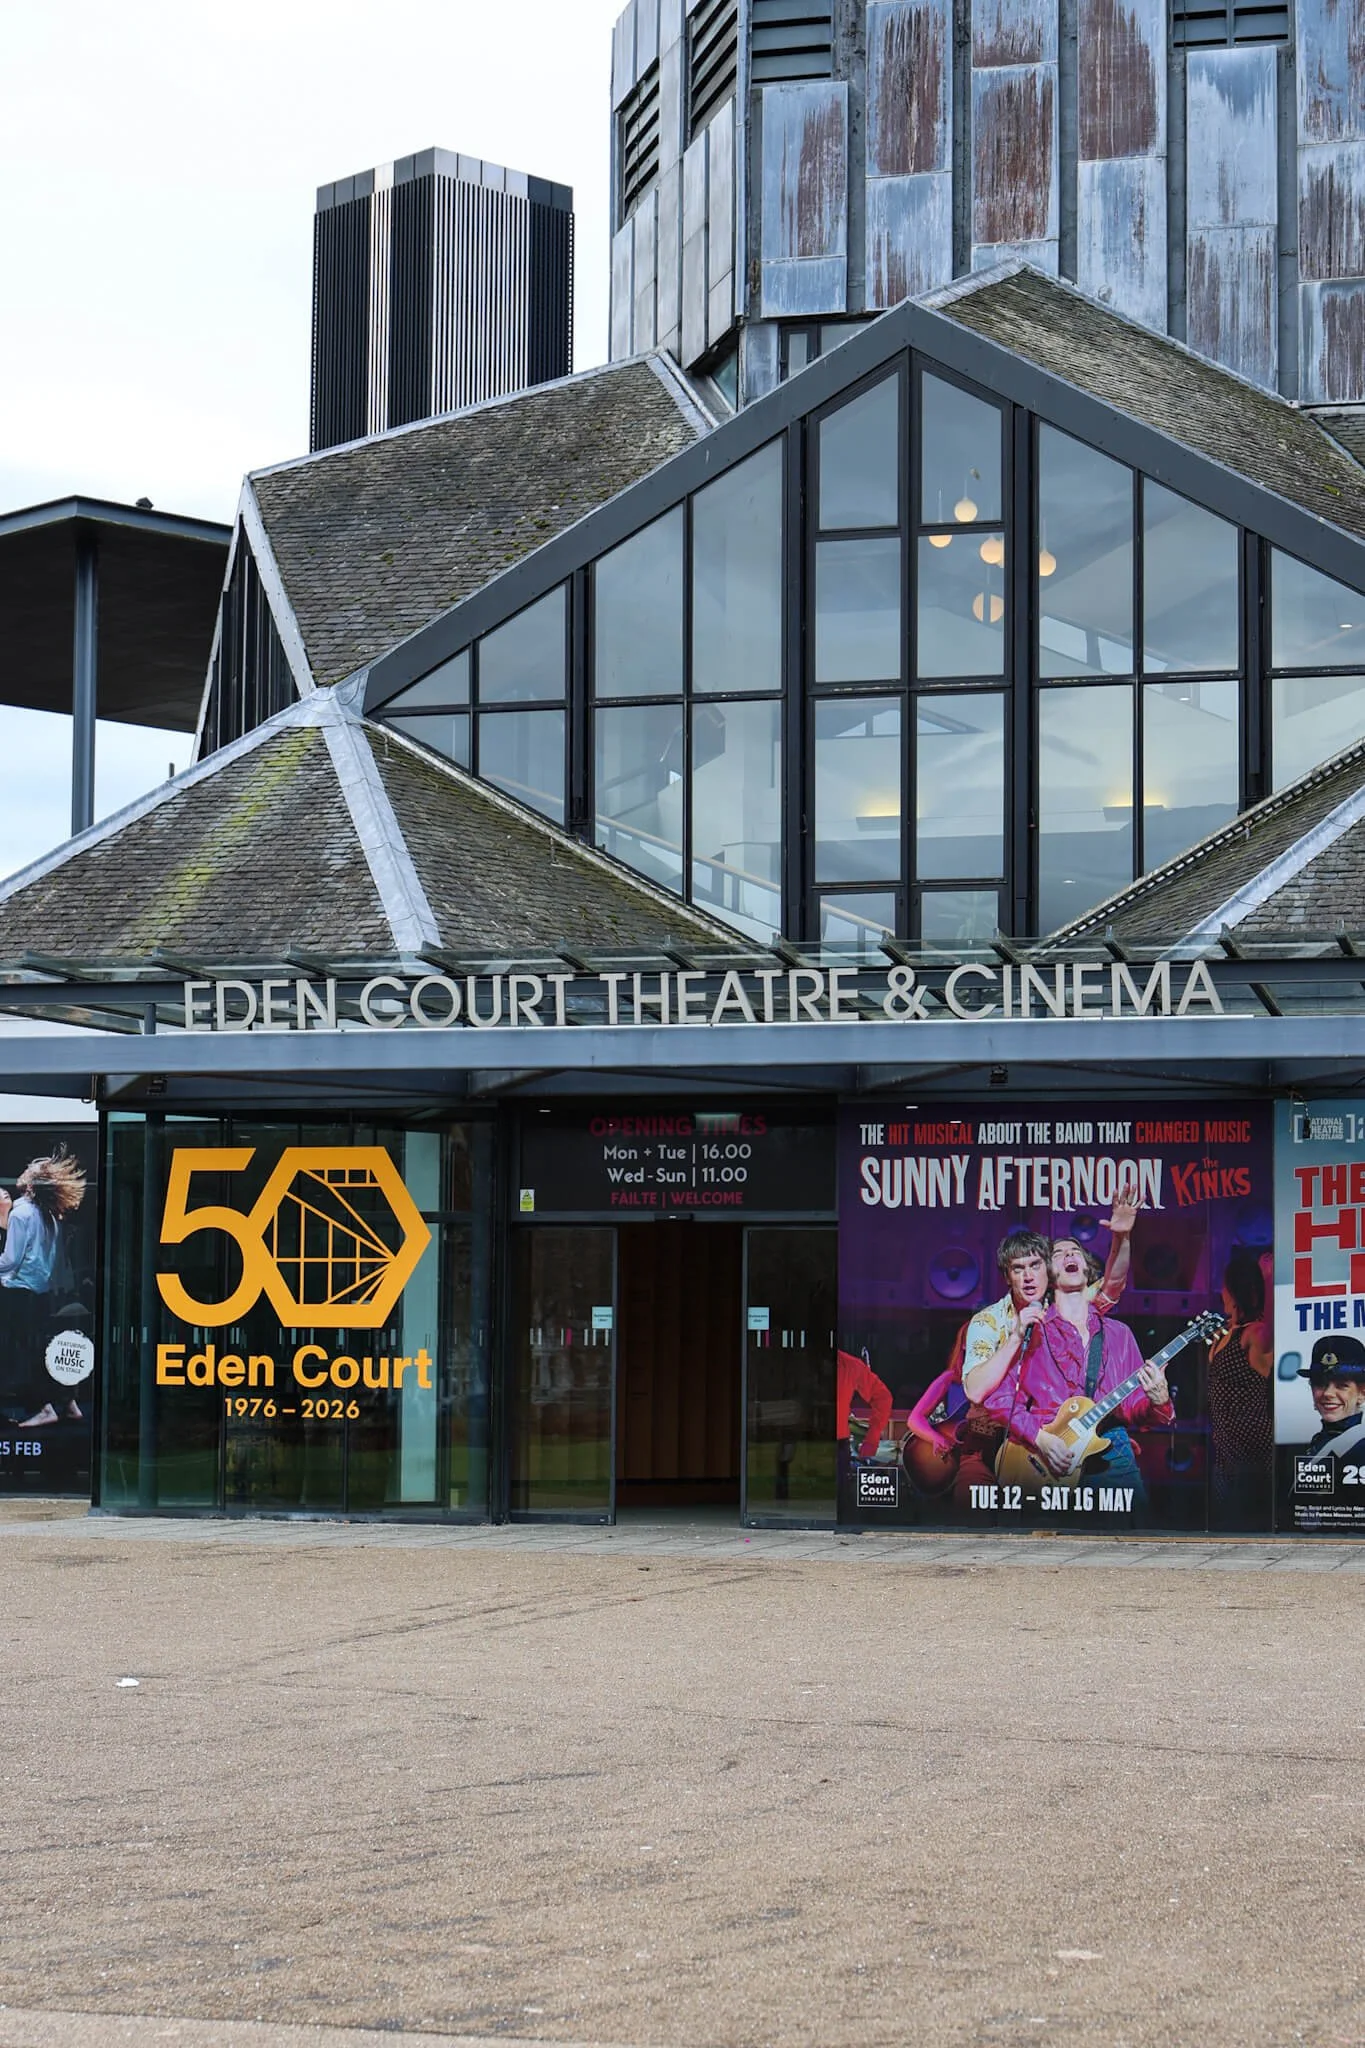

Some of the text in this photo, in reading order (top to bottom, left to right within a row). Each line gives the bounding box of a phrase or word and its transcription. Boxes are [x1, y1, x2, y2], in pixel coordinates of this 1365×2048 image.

[184, 960, 1225, 1031] EDEN COURT THEATRE & CINEMA
[589, 1116, 768, 1137] OPENING TIMES
[860, 1120, 1252, 1145] THE HIT MUSICAL ABOUT THE BAND THAT CHANGED MUSIC
[603, 1145, 638, 1160] Mon
[643, 1148, 652, 1157] +
[657, 1144, 687, 1160] Tue
[701, 1143, 752, 1160] 16.00
[1201, 1157, 1220, 1169] The
[701, 1167, 748, 1183] 11.00
[860, 1154, 1166, 1212] SUNNY AFTERNOON
[1294, 1162, 1365, 1208] THE
[670, 1191, 744, 1205] WELCOME
[1295, 1300, 1347, 1331] THE
[57, 1340, 88, 1350] FEATURING
[61, 1348, 81, 1359] LIVE
[54, 1356, 85, 1369] MUSIC
[156, 1344, 433, 1389] Eden Court
[15, 1441, 42, 1456] FEB
[1298, 1461, 1326, 1473] Eden
[860, 1473, 889, 1484] Eden
[1297, 1473, 1332, 1483] Court
[860, 1484, 895, 1496] Court
[969, 1485, 999, 1509] TUE
[1002, 1485, 1022, 1509] 12
[1041, 1486, 1070, 1511] SAT
[1073, 1486, 1093, 1511] 16
[1098, 1487, 1134, 1512] MAY
